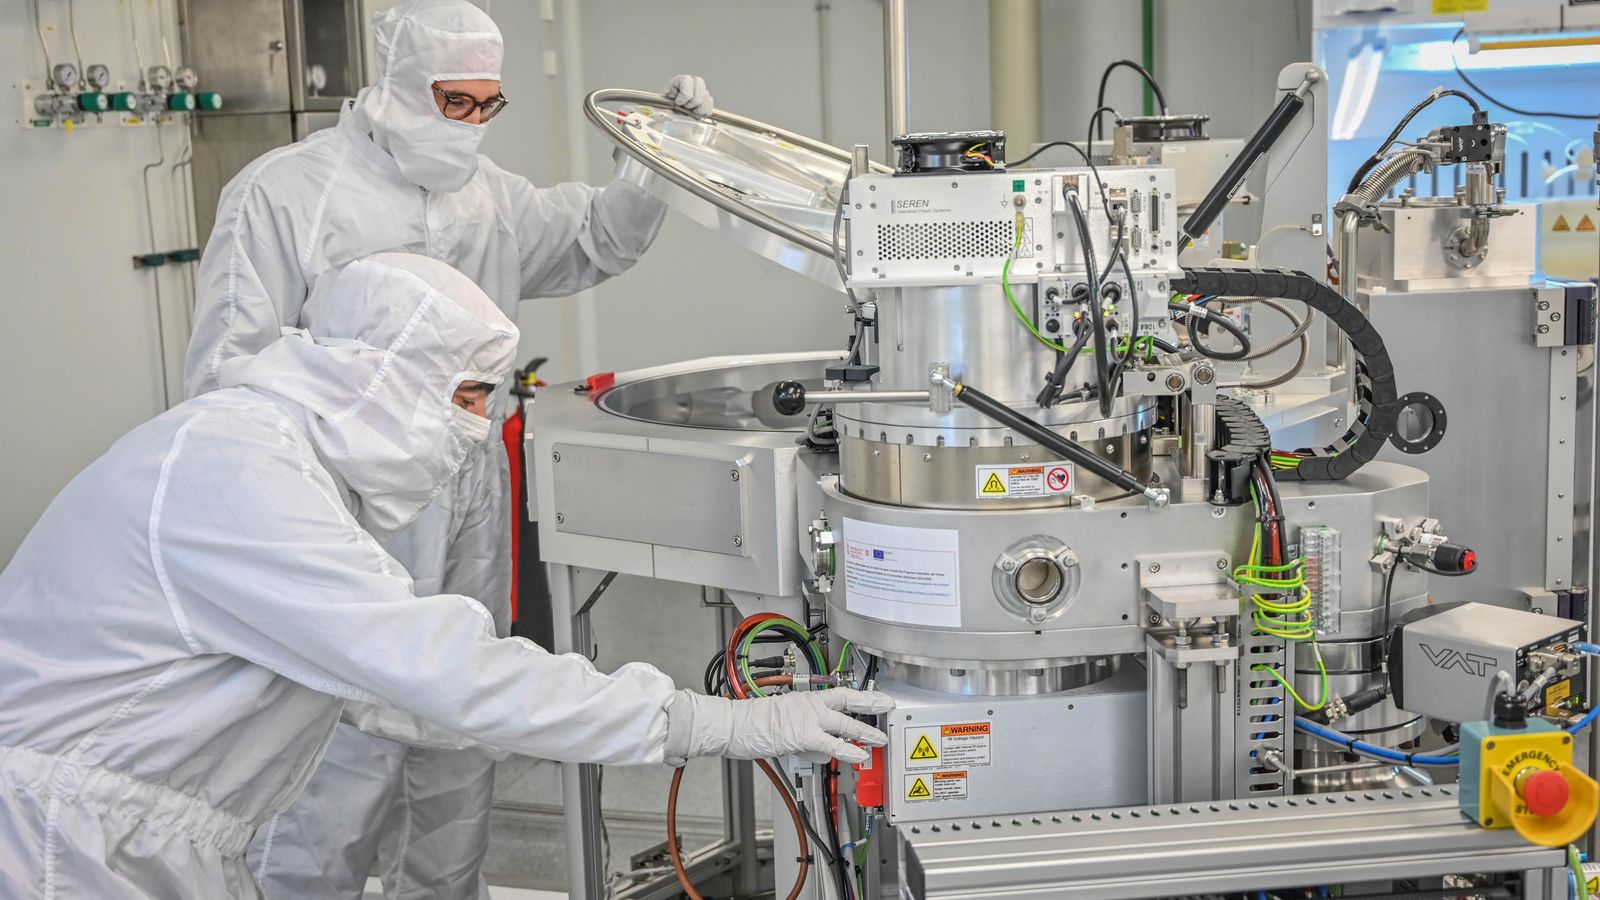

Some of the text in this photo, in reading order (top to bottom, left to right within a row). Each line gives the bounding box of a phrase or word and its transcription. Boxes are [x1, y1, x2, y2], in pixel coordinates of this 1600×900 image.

[896, 199, 930, 209] SEREN
[1419, 643, 1497, 677] VAT
[950, 724, 989, 734] WARNING
[1502, 750, 1561, 776] EMERGENCY
